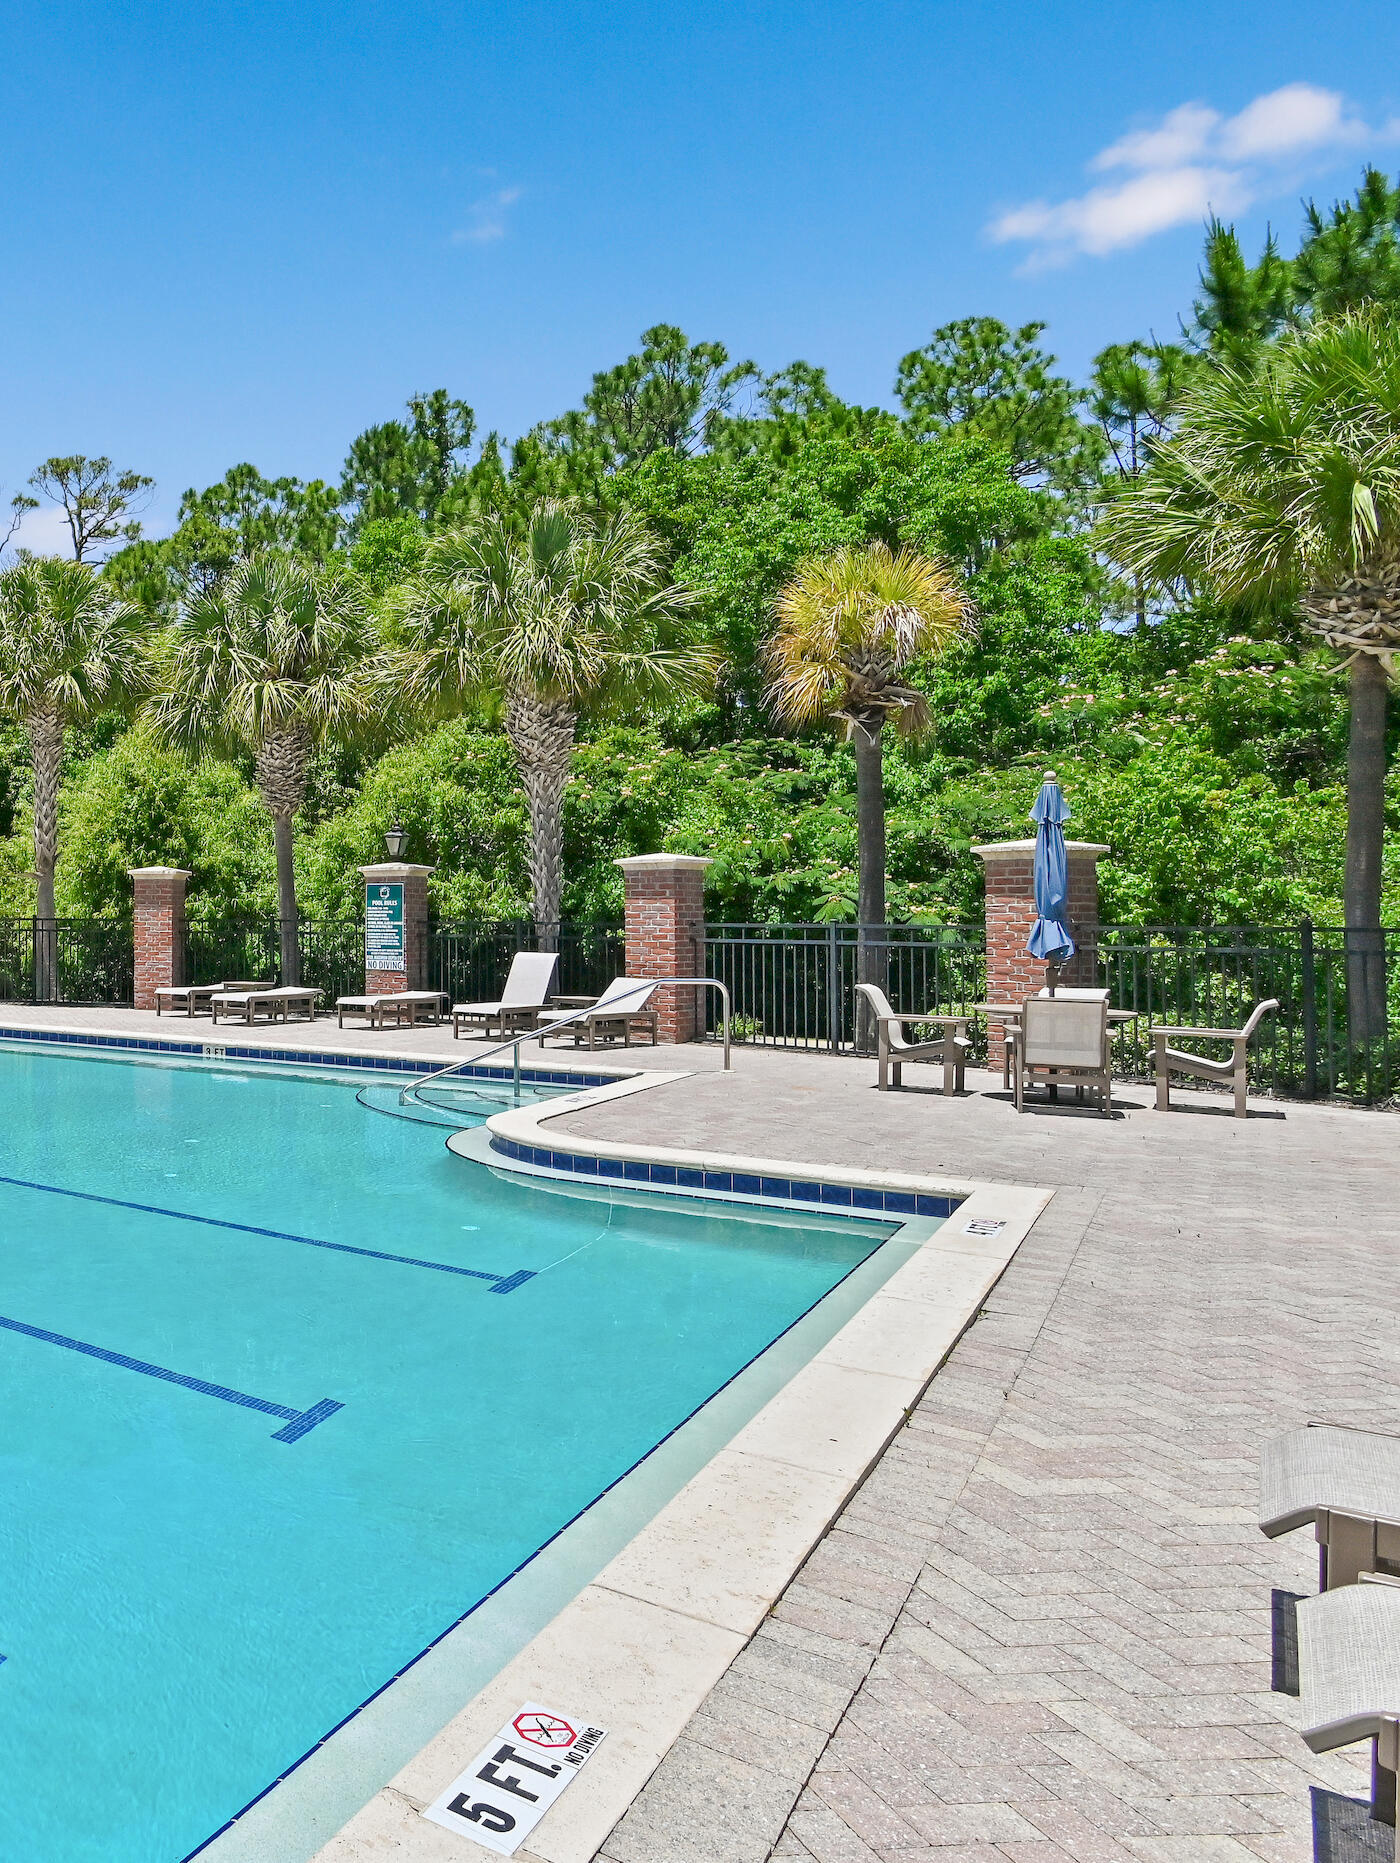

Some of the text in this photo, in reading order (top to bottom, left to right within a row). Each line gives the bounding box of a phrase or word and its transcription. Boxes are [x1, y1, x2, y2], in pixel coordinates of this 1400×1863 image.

[379, 961, 403, 969] DIVING
[205, 1047, 211, 1055] 3
[563, 1751, 585, 1766] NO
[574, 1727, 604, 1754] DIVING
[446, 1744, 563, 1833] 5 FT.
